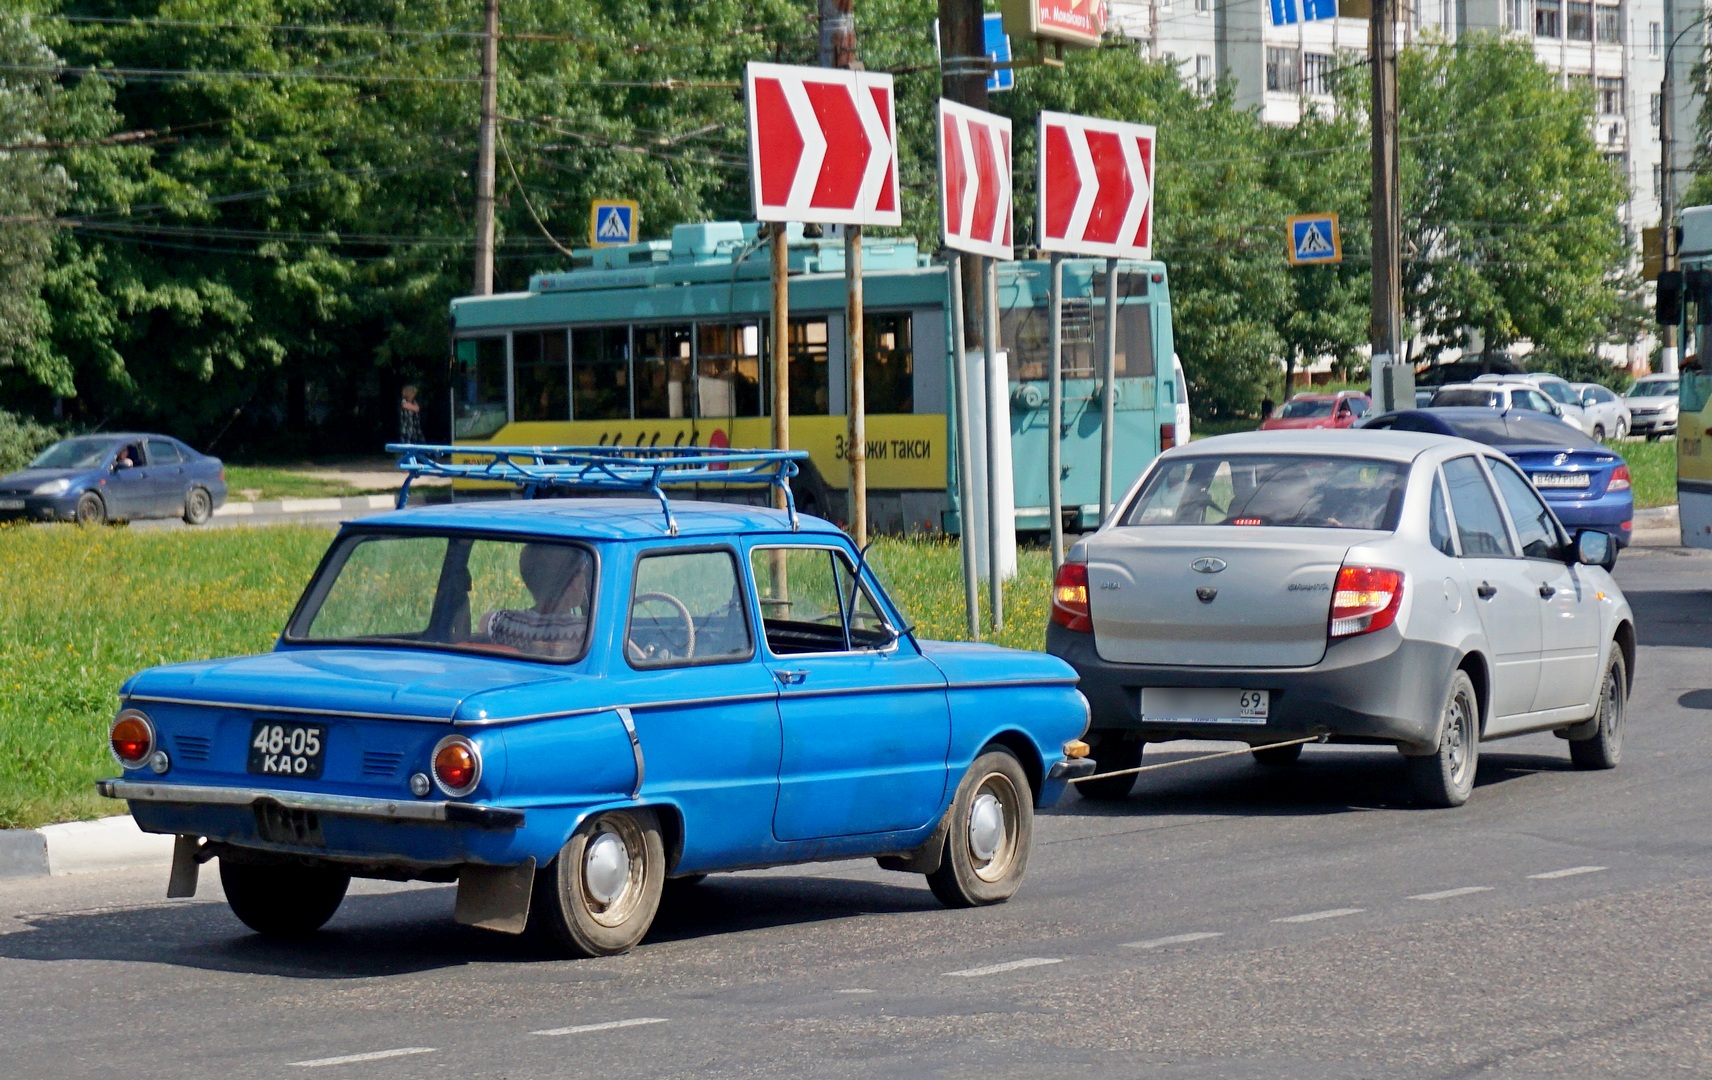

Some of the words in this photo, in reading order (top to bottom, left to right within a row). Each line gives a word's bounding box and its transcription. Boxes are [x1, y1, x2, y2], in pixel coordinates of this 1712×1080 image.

[835, 434, 887, 459] Зжи
[891, 440, 931, 459] такси
[1240, 692, 1261, 708] 69
[253, 725, 320, 756] 48-05
[263, 754, 308, 773] КАО
